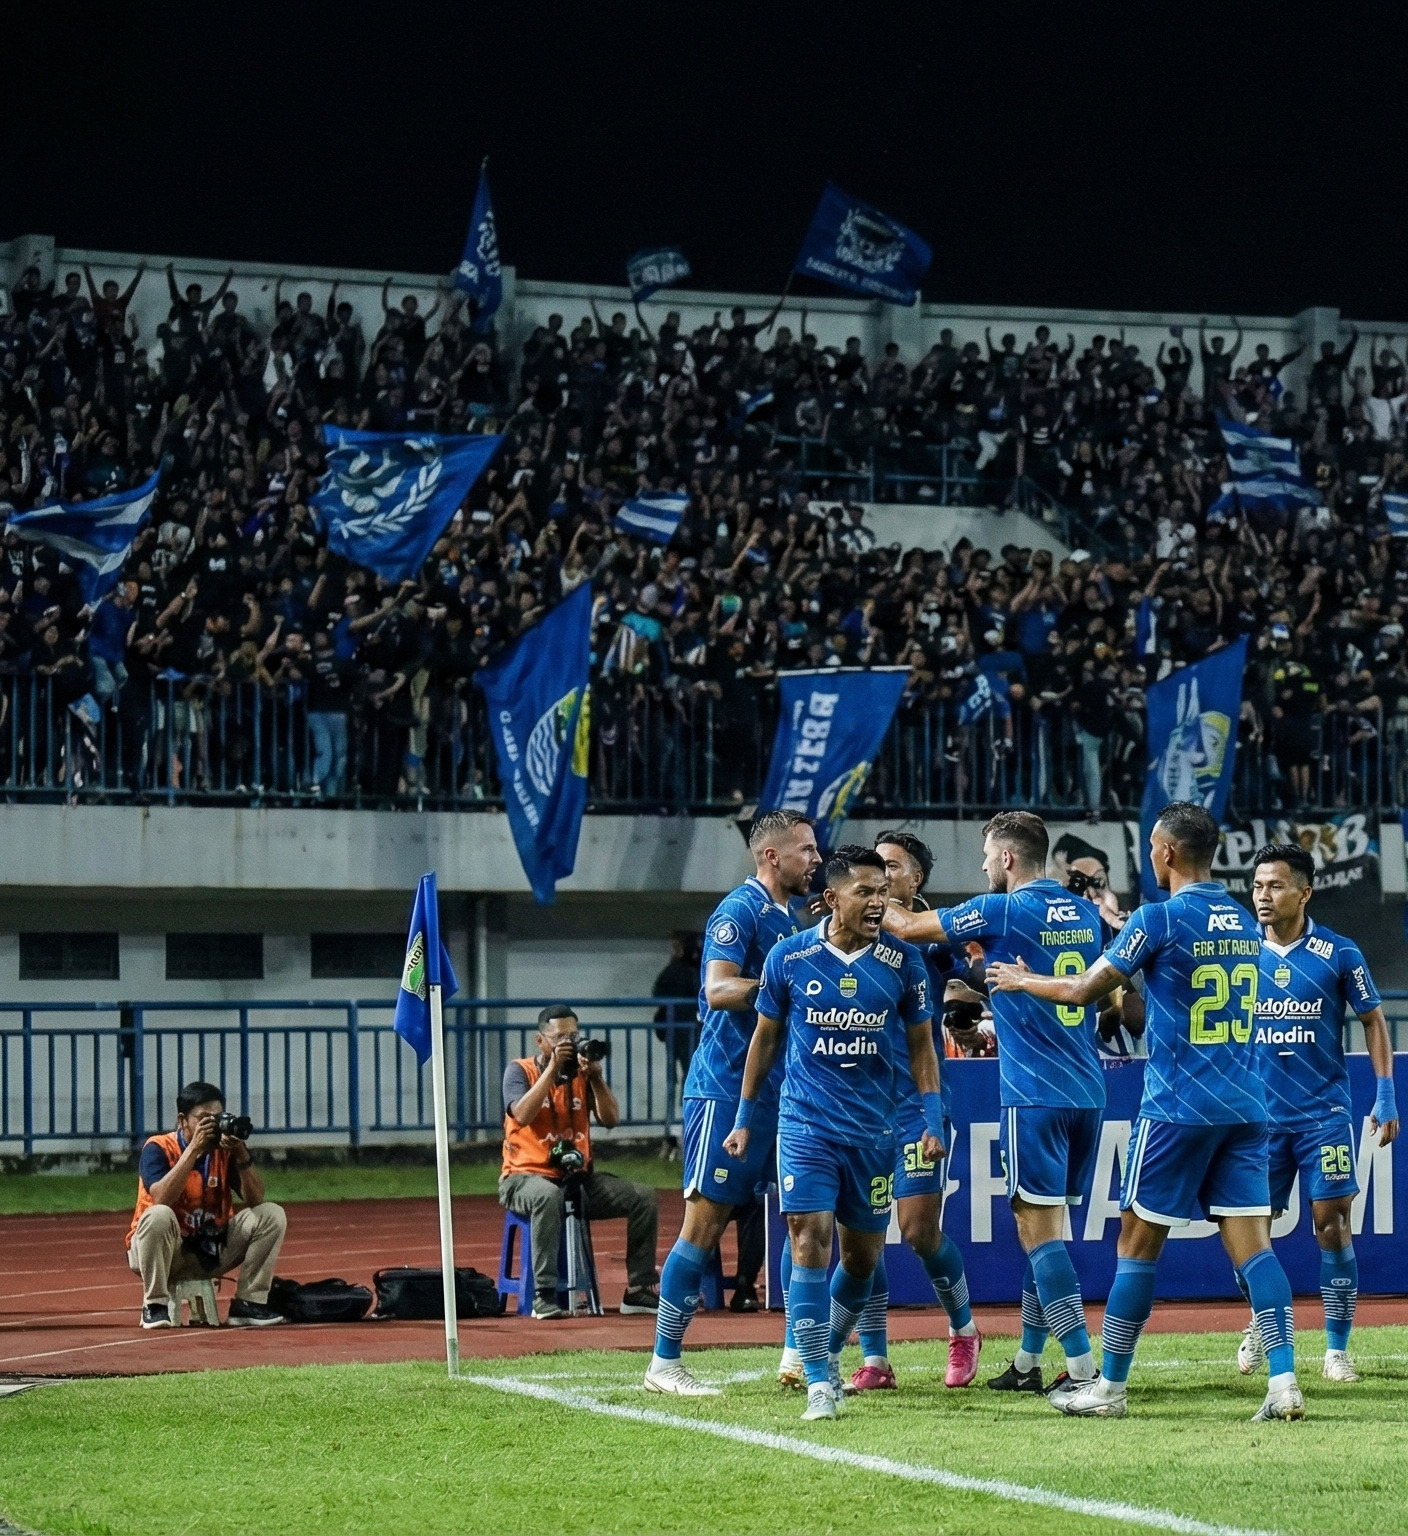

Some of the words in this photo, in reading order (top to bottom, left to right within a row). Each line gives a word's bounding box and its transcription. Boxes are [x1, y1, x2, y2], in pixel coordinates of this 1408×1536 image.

[1189, 963, 1259, 1045] 23
[1253, 997, 1323, 1020] ndofood
[805, 1006, 889, 1031] Indofood
[812, 1036, 878, 1056] Aladin
[1254, 1025, 1316, 1044] Aladin
[1320, 1144, 1351, 1173] 26
